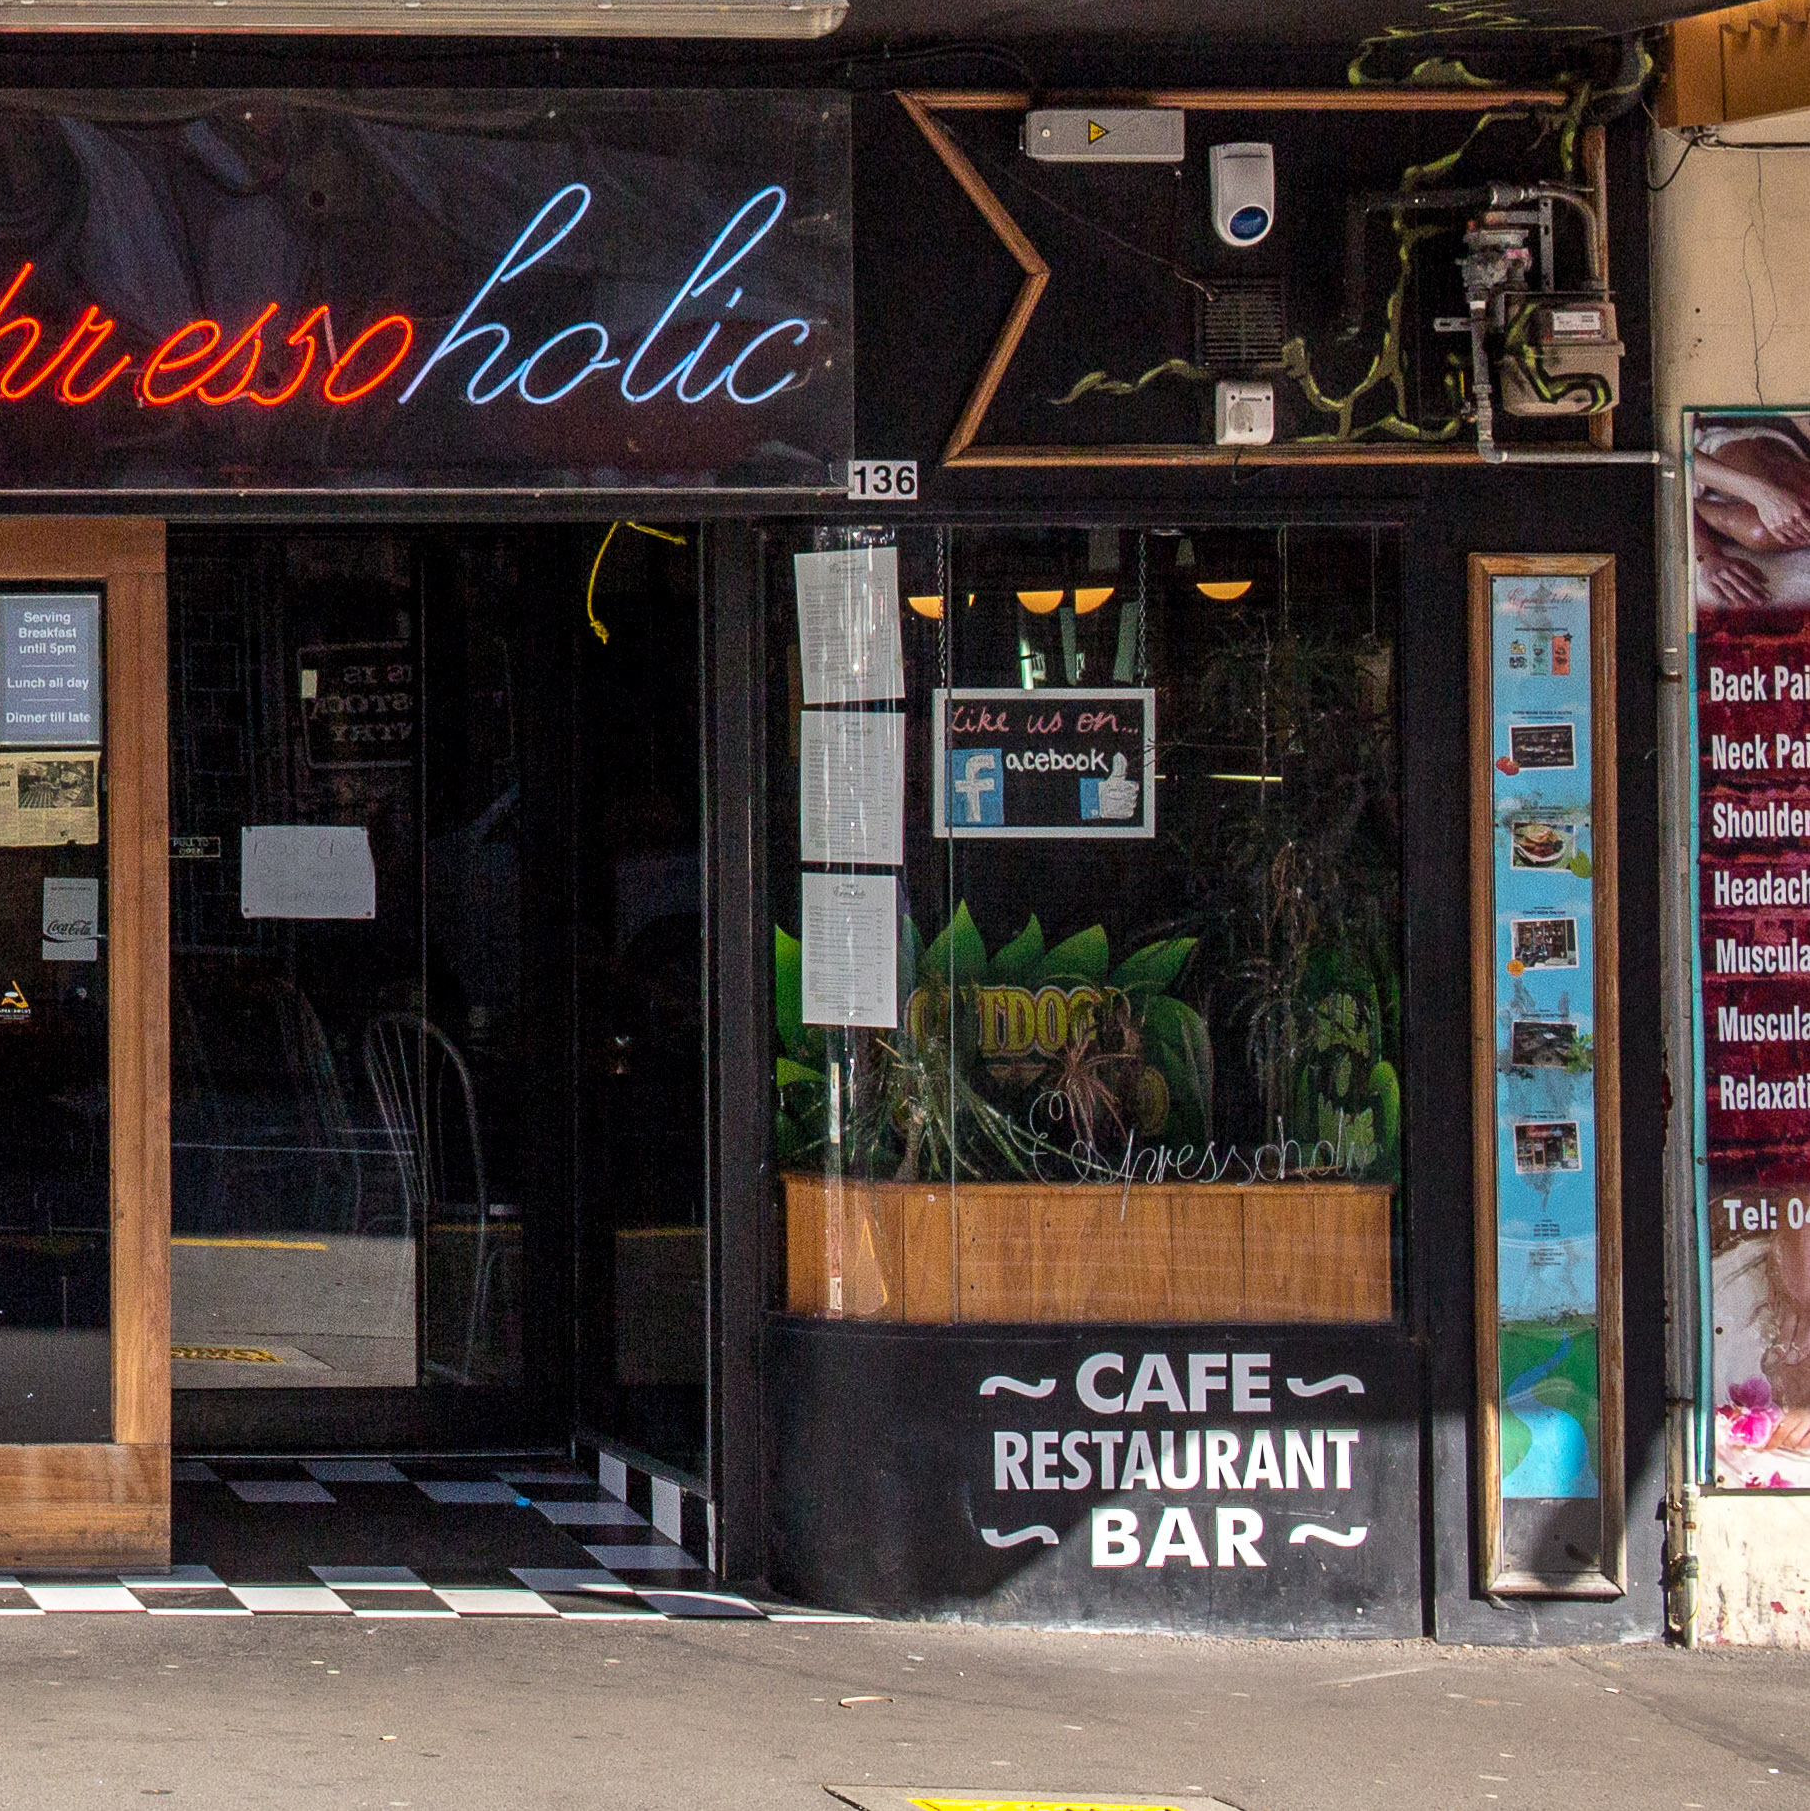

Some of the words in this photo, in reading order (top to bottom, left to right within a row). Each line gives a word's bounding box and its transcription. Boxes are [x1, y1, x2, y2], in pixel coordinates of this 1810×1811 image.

[853, 466, 917, 496] 136
[18, 627, 77, 638] Breakfast
[23, 612, 71, 625] Serving
[19, 643, 46, 654] until
[50, 643, 77, 655] 5pm
[7, 677, 45, 689] Lunch
[49, 677, 63, 688] all
[67, 677, 89, 690] day
[1709, 665, 1767, 701] Back
[6, 711, 46, 723] Dinner
[50, 711, 64, 722] till
[69, 711, 91, 723] late
[950, 705, 1009, 733] Like
[1027, 711, 1063, 734] us
[1711, 734, 1769, 770] Neck
[1723, 1198, 1777, 1230] Tel:
[1076, 1352, 1271, 1414] CAFE
[993, 1429, 1360, 1490] RESTAURANT
[1091, 1506, 1268, 1568] BAR
